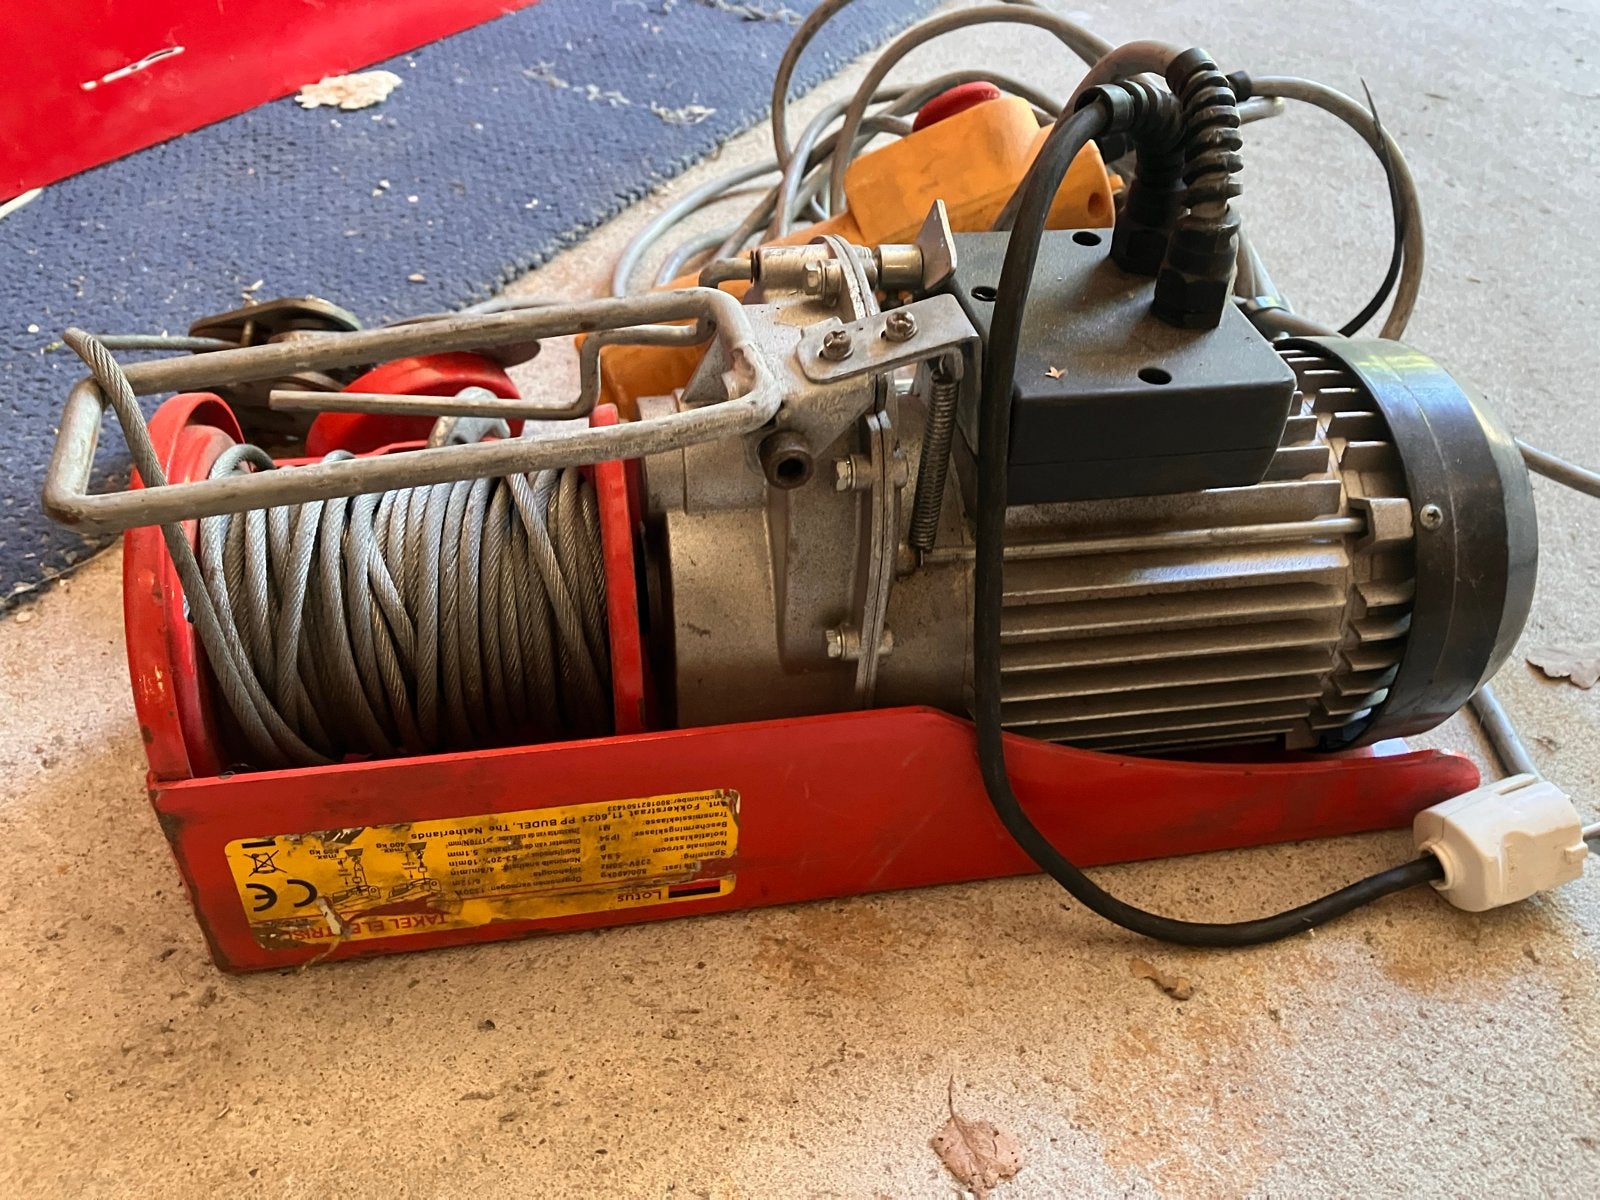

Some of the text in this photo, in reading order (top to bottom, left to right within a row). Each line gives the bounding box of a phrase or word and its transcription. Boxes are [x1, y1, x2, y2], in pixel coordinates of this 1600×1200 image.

[629, 802, 699, 816] Fokkerstraat
[512, 817, 556, 829] BUDEL,
[642, 811, 727, 825] Transmissieklasse:
[410, 826, 482, 840] Netherlands
[488, 824, 509, 832] The
[599, 820, 727, 841] Beschermingsklasse: IP54
[549, 838, 580, 846] Diameter
[686, 840, 726, 849] Nominale
[680, 848, 725, 860] Spanning:
[617, 890, 661, 904] Lotus
[388, 913, 447, 929] TAKEL
